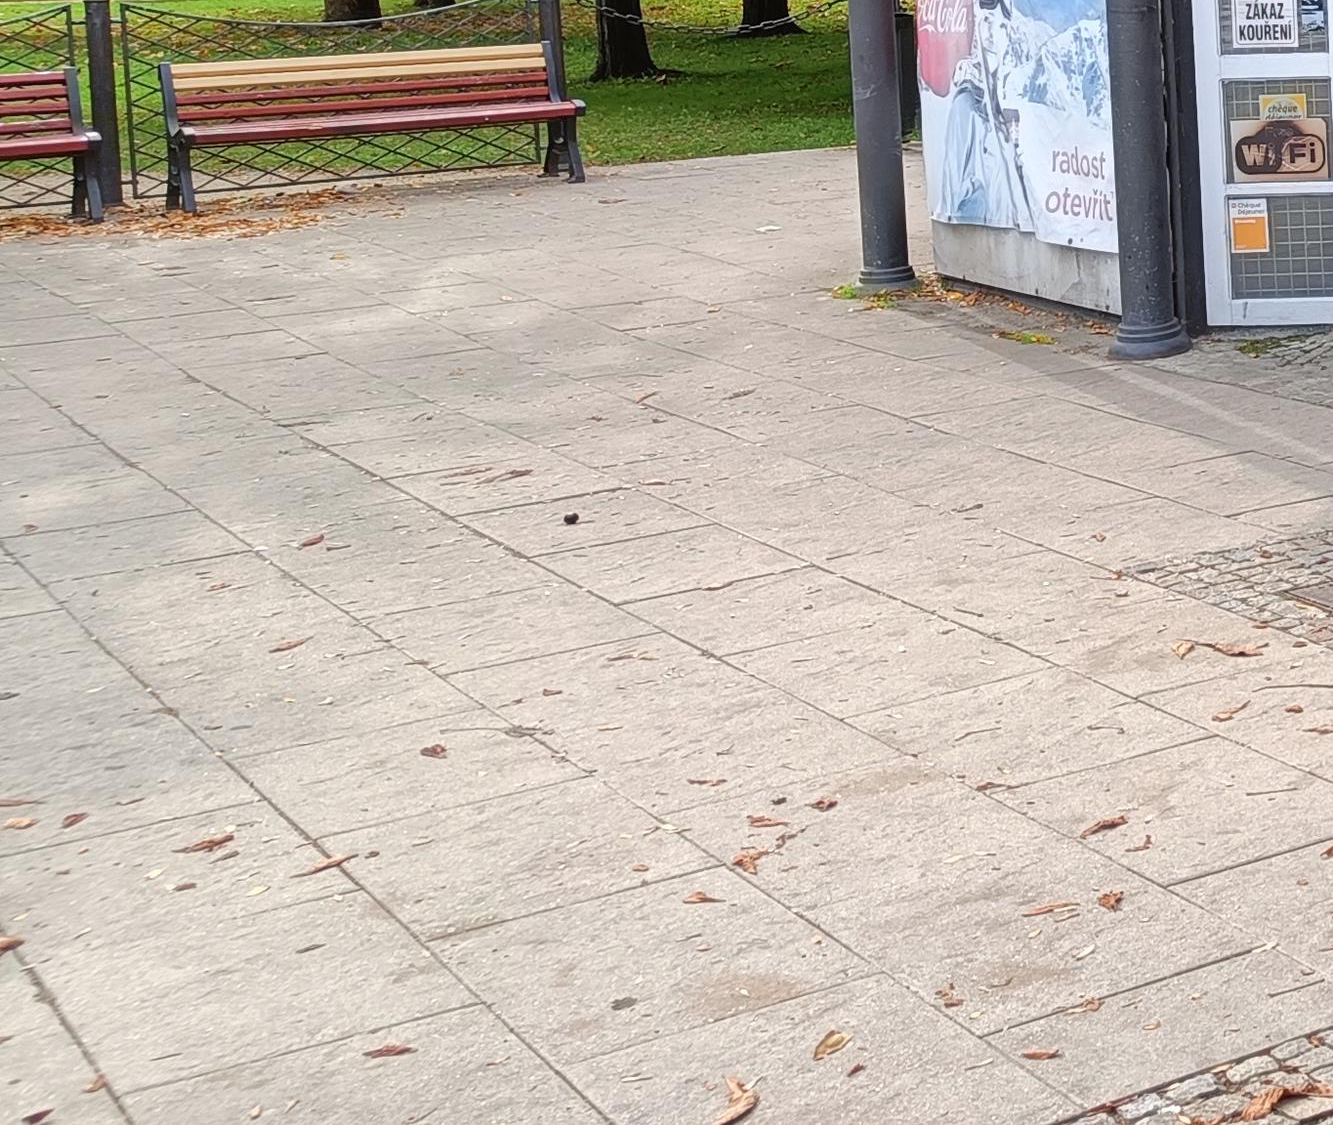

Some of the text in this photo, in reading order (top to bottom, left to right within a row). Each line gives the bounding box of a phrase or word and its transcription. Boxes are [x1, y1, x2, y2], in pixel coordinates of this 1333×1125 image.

[1246, 0, 1285, 20] ZÁKAZ
[1239, 19, 1292, 41] KOUŘENÍ
[1052, 146, 1106, 180] radost
